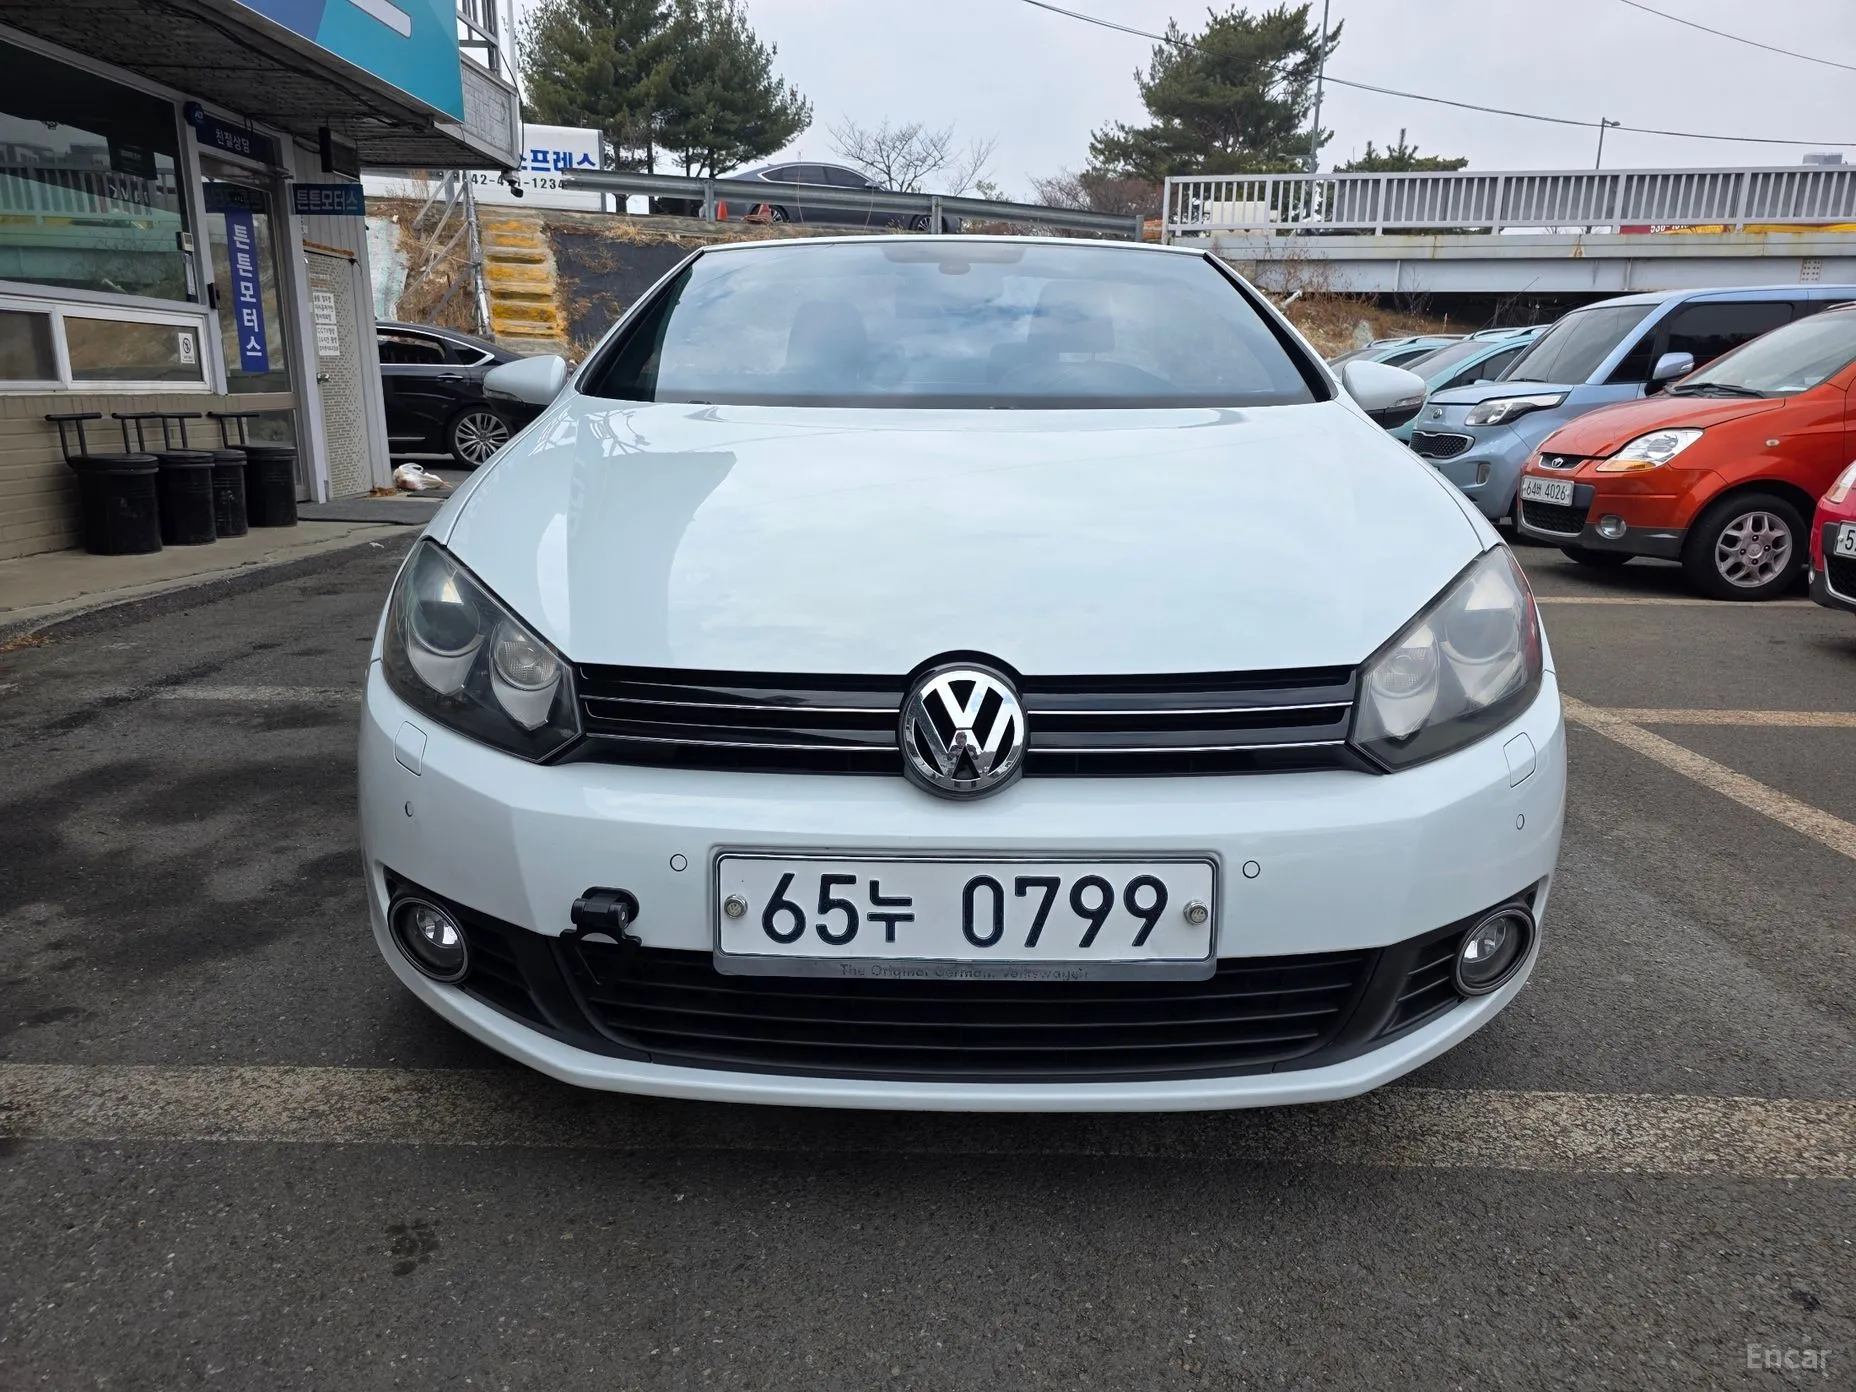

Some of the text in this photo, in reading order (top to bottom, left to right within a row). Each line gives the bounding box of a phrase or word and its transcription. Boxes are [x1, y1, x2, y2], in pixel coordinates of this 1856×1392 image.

[216, 128, 250, 153] 친절상담
[296, 190, 358, 211] 튼튼모터스
[234, 224, 263, 357] 튼튼모터스
[1544, 483, 1567, 501] 4026
[1845, 529, 1856, 551] 5
[761, 872, 1169, 948] 65누 0799
[840, 963, 865, 976] The
[871, 963, 929, 979] Original
